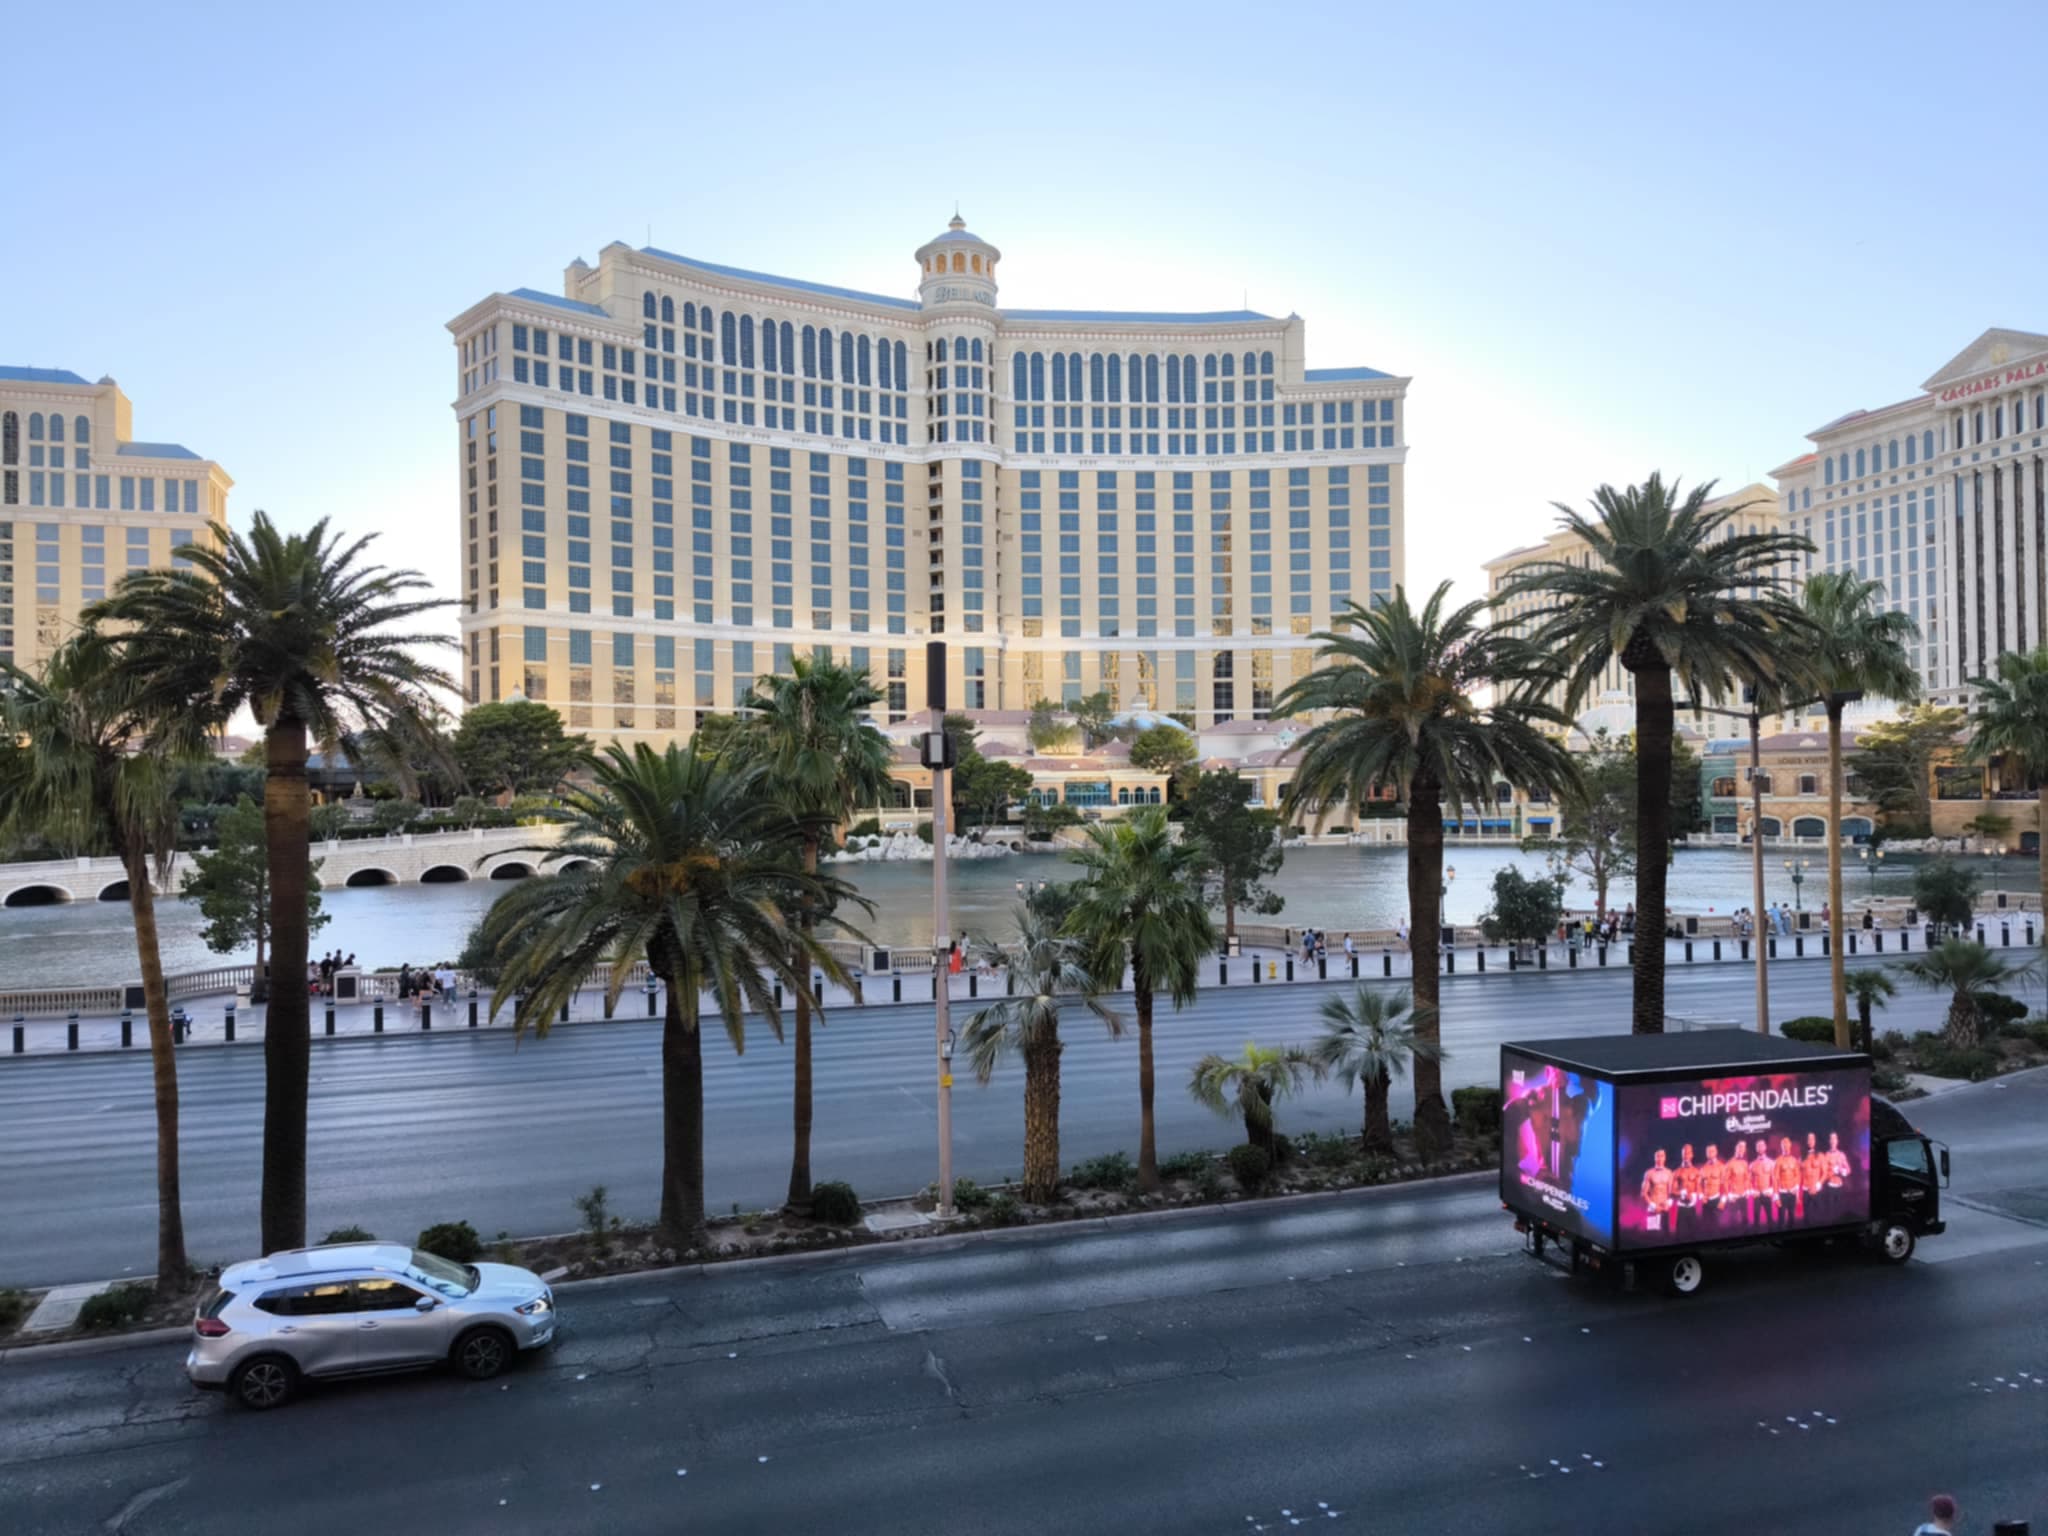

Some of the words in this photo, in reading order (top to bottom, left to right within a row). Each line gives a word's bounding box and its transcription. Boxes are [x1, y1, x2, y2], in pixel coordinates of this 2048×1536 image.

[1942, 376, 2001, 401] CAESARS
[2005, 362, 2048, 385] PALA
[1678, 1085, 1830, 1117] CHIPPENDALES
